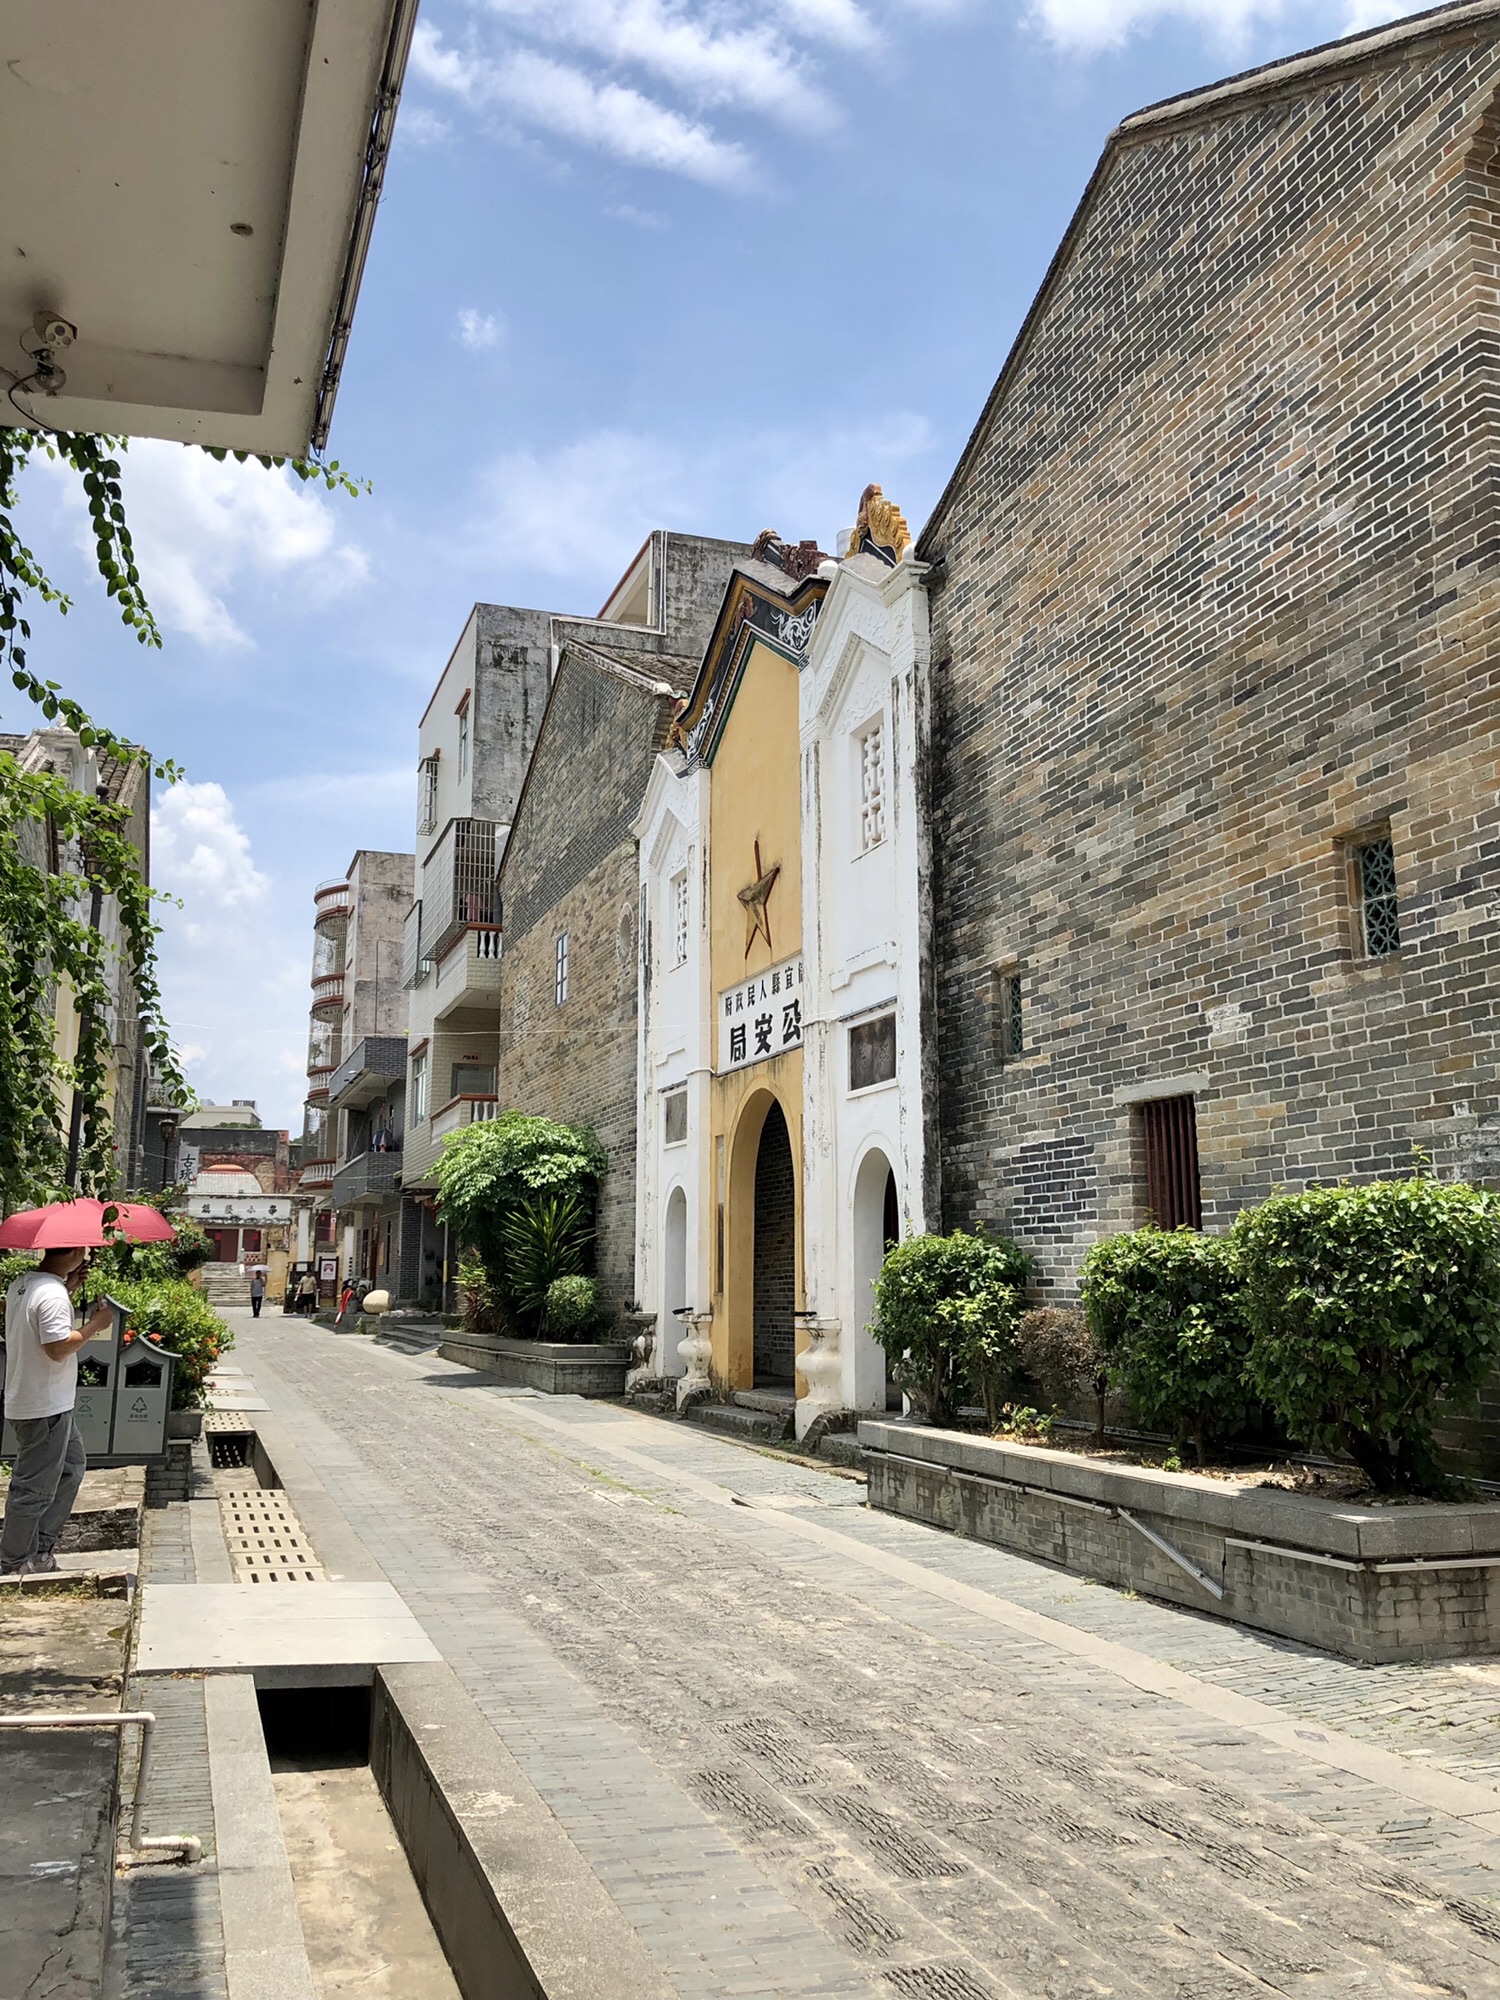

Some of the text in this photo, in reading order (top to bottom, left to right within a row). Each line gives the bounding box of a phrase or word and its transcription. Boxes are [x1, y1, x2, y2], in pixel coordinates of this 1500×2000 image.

[729, 998, 802, 1064] 公安局
[179, 1153, 196, 1181] 古玩
